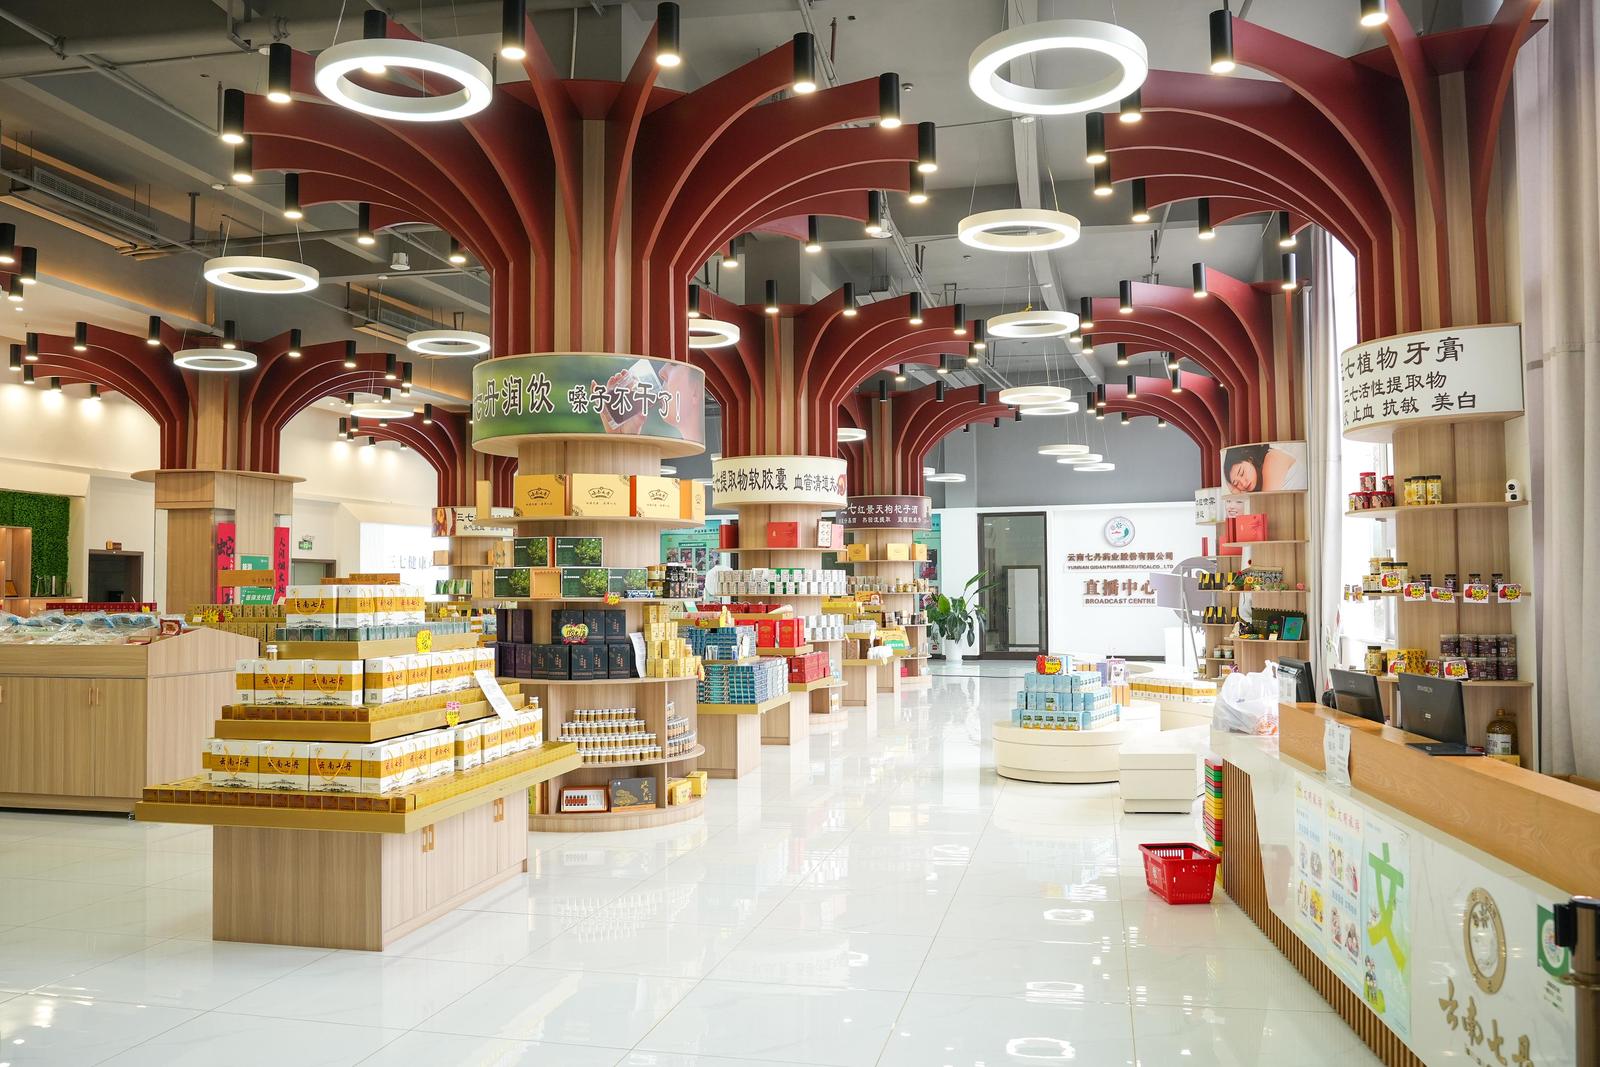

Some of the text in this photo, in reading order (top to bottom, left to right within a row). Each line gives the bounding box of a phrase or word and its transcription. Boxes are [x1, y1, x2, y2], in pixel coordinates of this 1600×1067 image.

[1344, 371, 1447, 402] 三七活性提取物
[567, 382, 681, 423] 嗓子不干了!
[1352, 403, 1375, 422] 止血
[1382, 397, 1420, 417] 抗敏
[1432, 391, 1476, 411] 美白
[793, 473, 838, 492] 血管清道夫
[1067, 552, 1174, 561] 云南七丹药业股份有限公司
[1083, 578, 1157, 596] 直播中心
